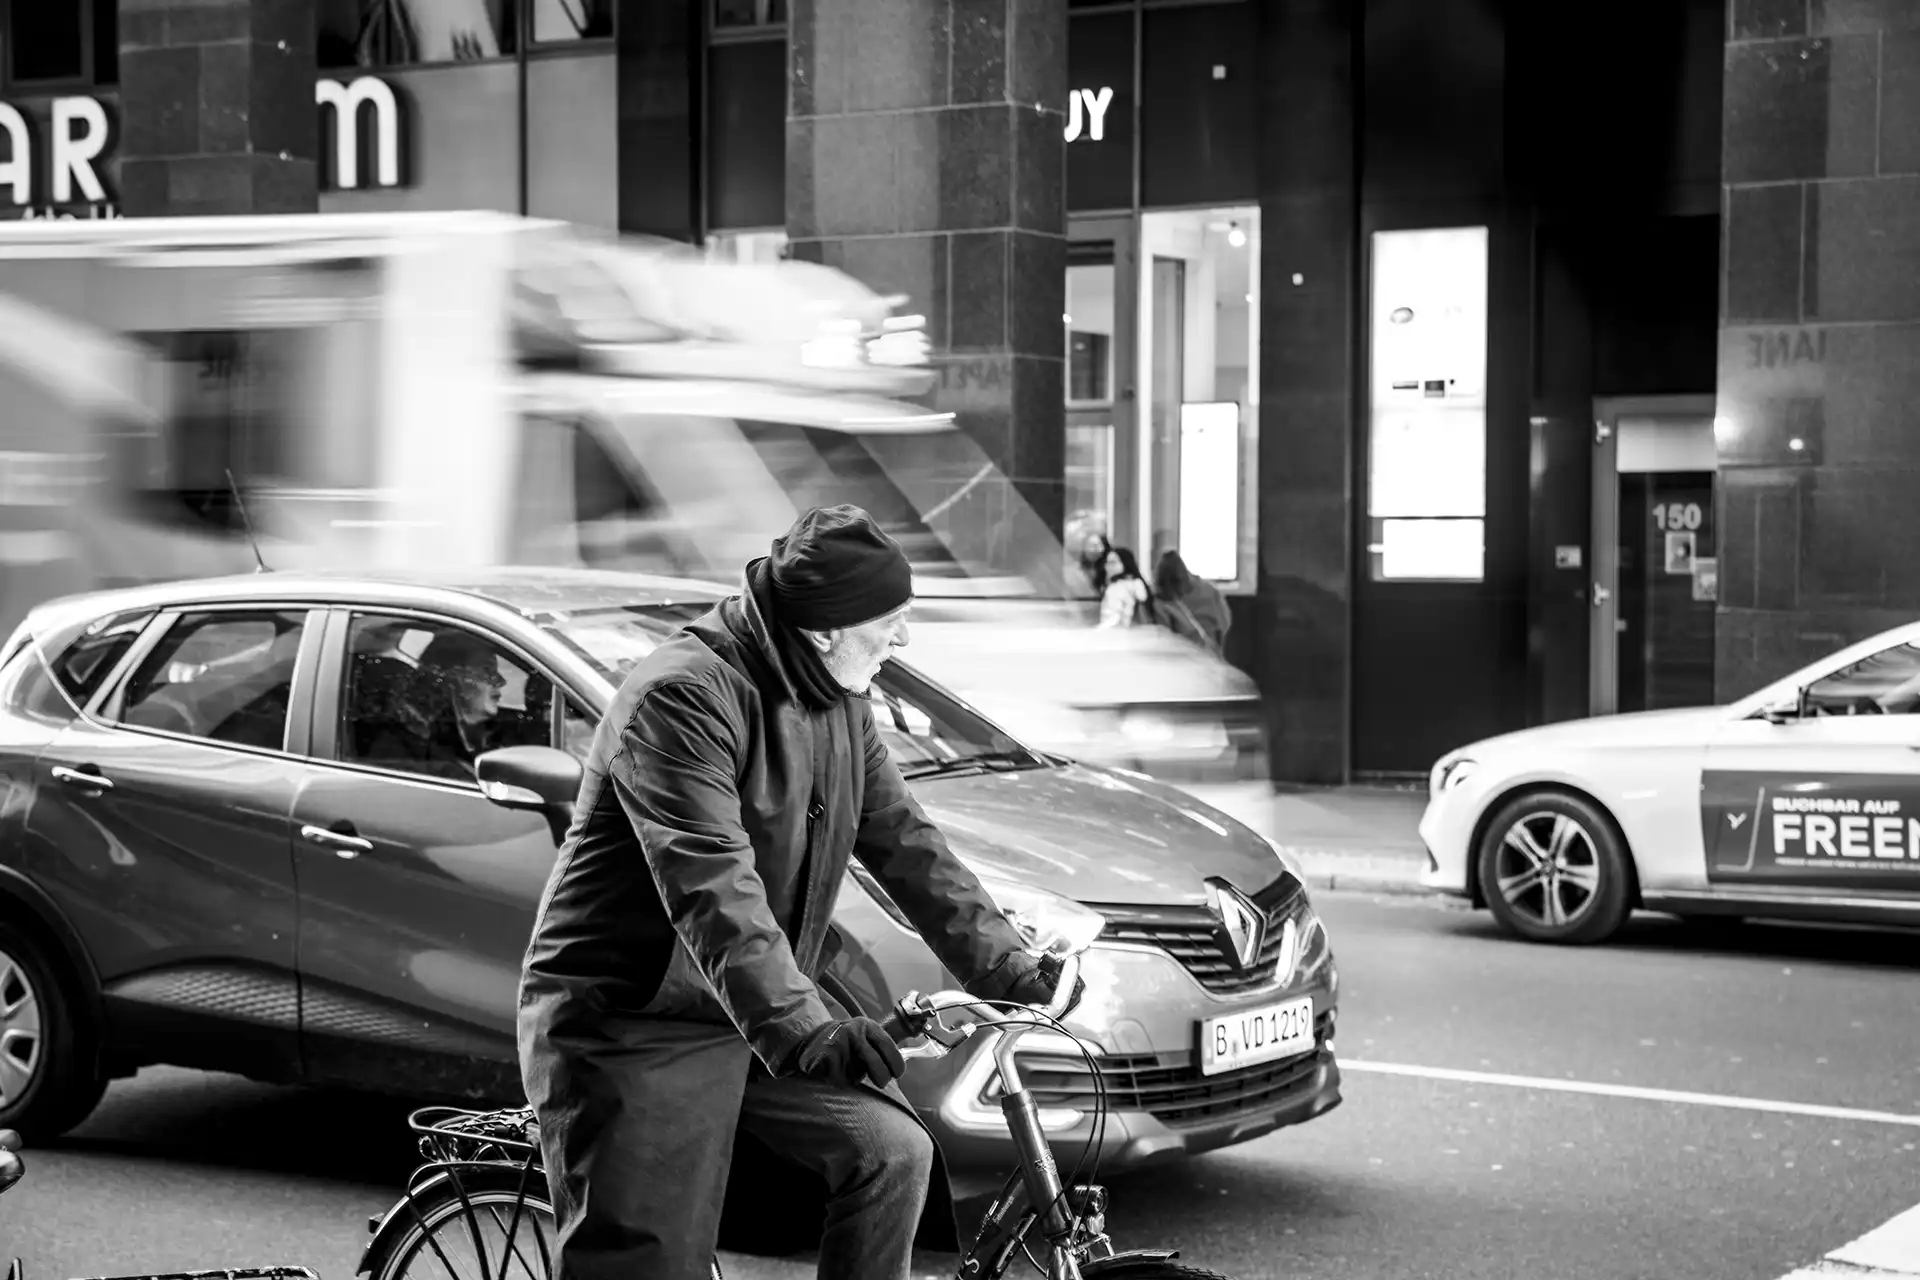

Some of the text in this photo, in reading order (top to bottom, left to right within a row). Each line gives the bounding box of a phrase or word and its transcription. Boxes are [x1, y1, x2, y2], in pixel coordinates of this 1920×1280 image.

[1652, 502, 1702, 530] 150
[1772, 797, 1901, 815] BUCHBAR AUF
[1216, 1024, 1228, 1056] B
[1241, 1015, 1264, 1050] VD
